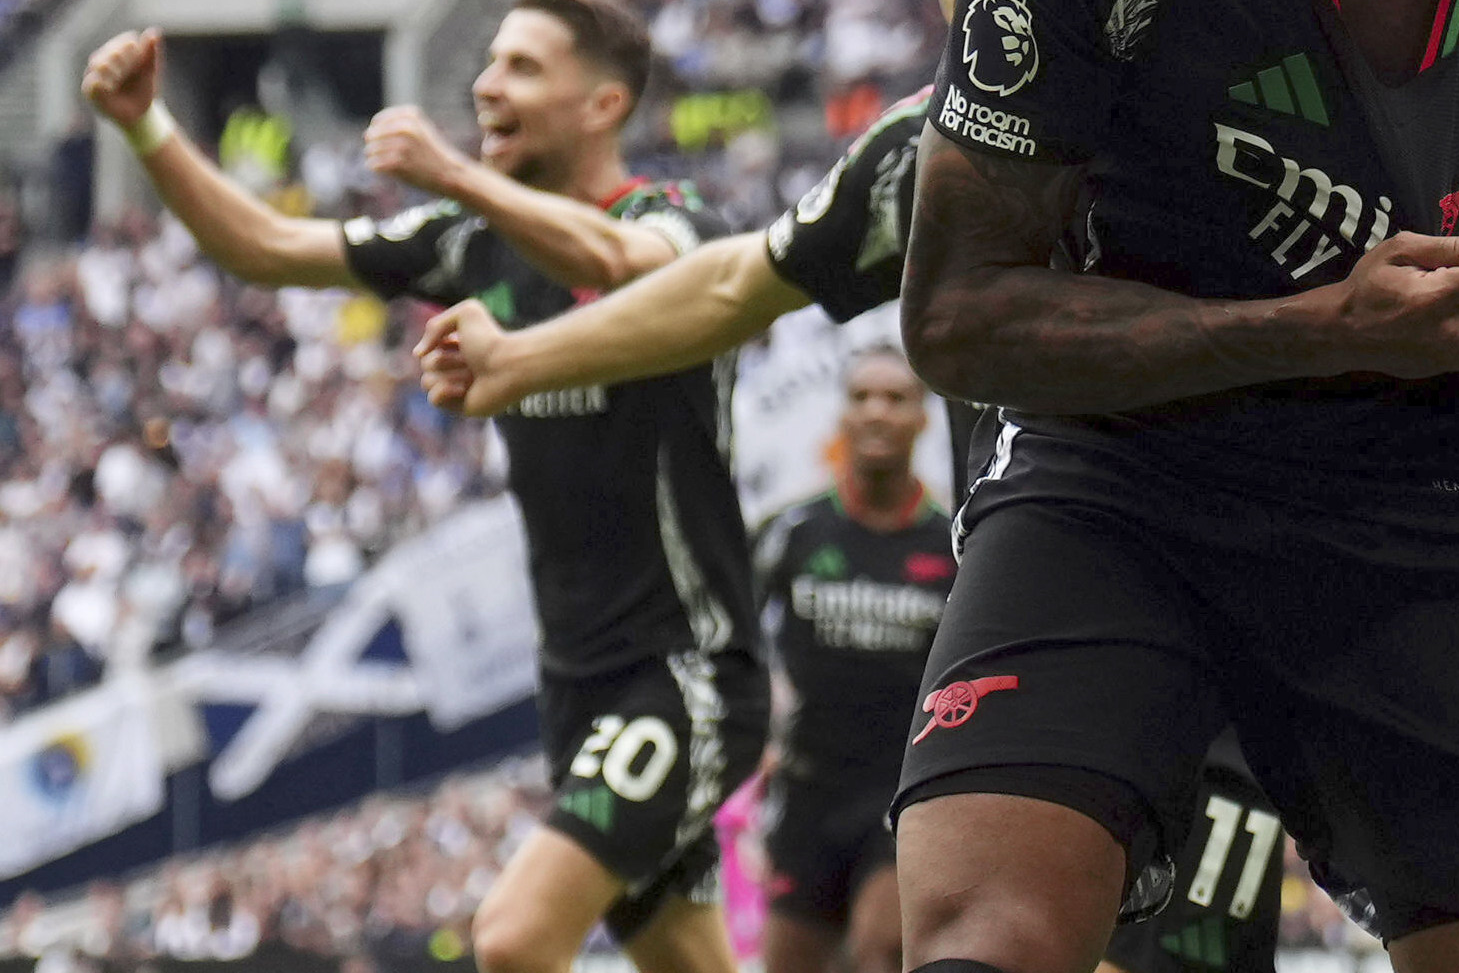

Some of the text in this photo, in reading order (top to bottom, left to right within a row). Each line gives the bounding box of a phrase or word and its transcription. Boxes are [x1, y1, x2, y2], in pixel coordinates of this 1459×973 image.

[939, 103, 1037, 156] for racism
[943, 84, 1031, 136] No room
[1248, 200, 1343, 281] FLY
[569, 714, 678, 803] 20
[1187, 795, 1281, 919] 11
